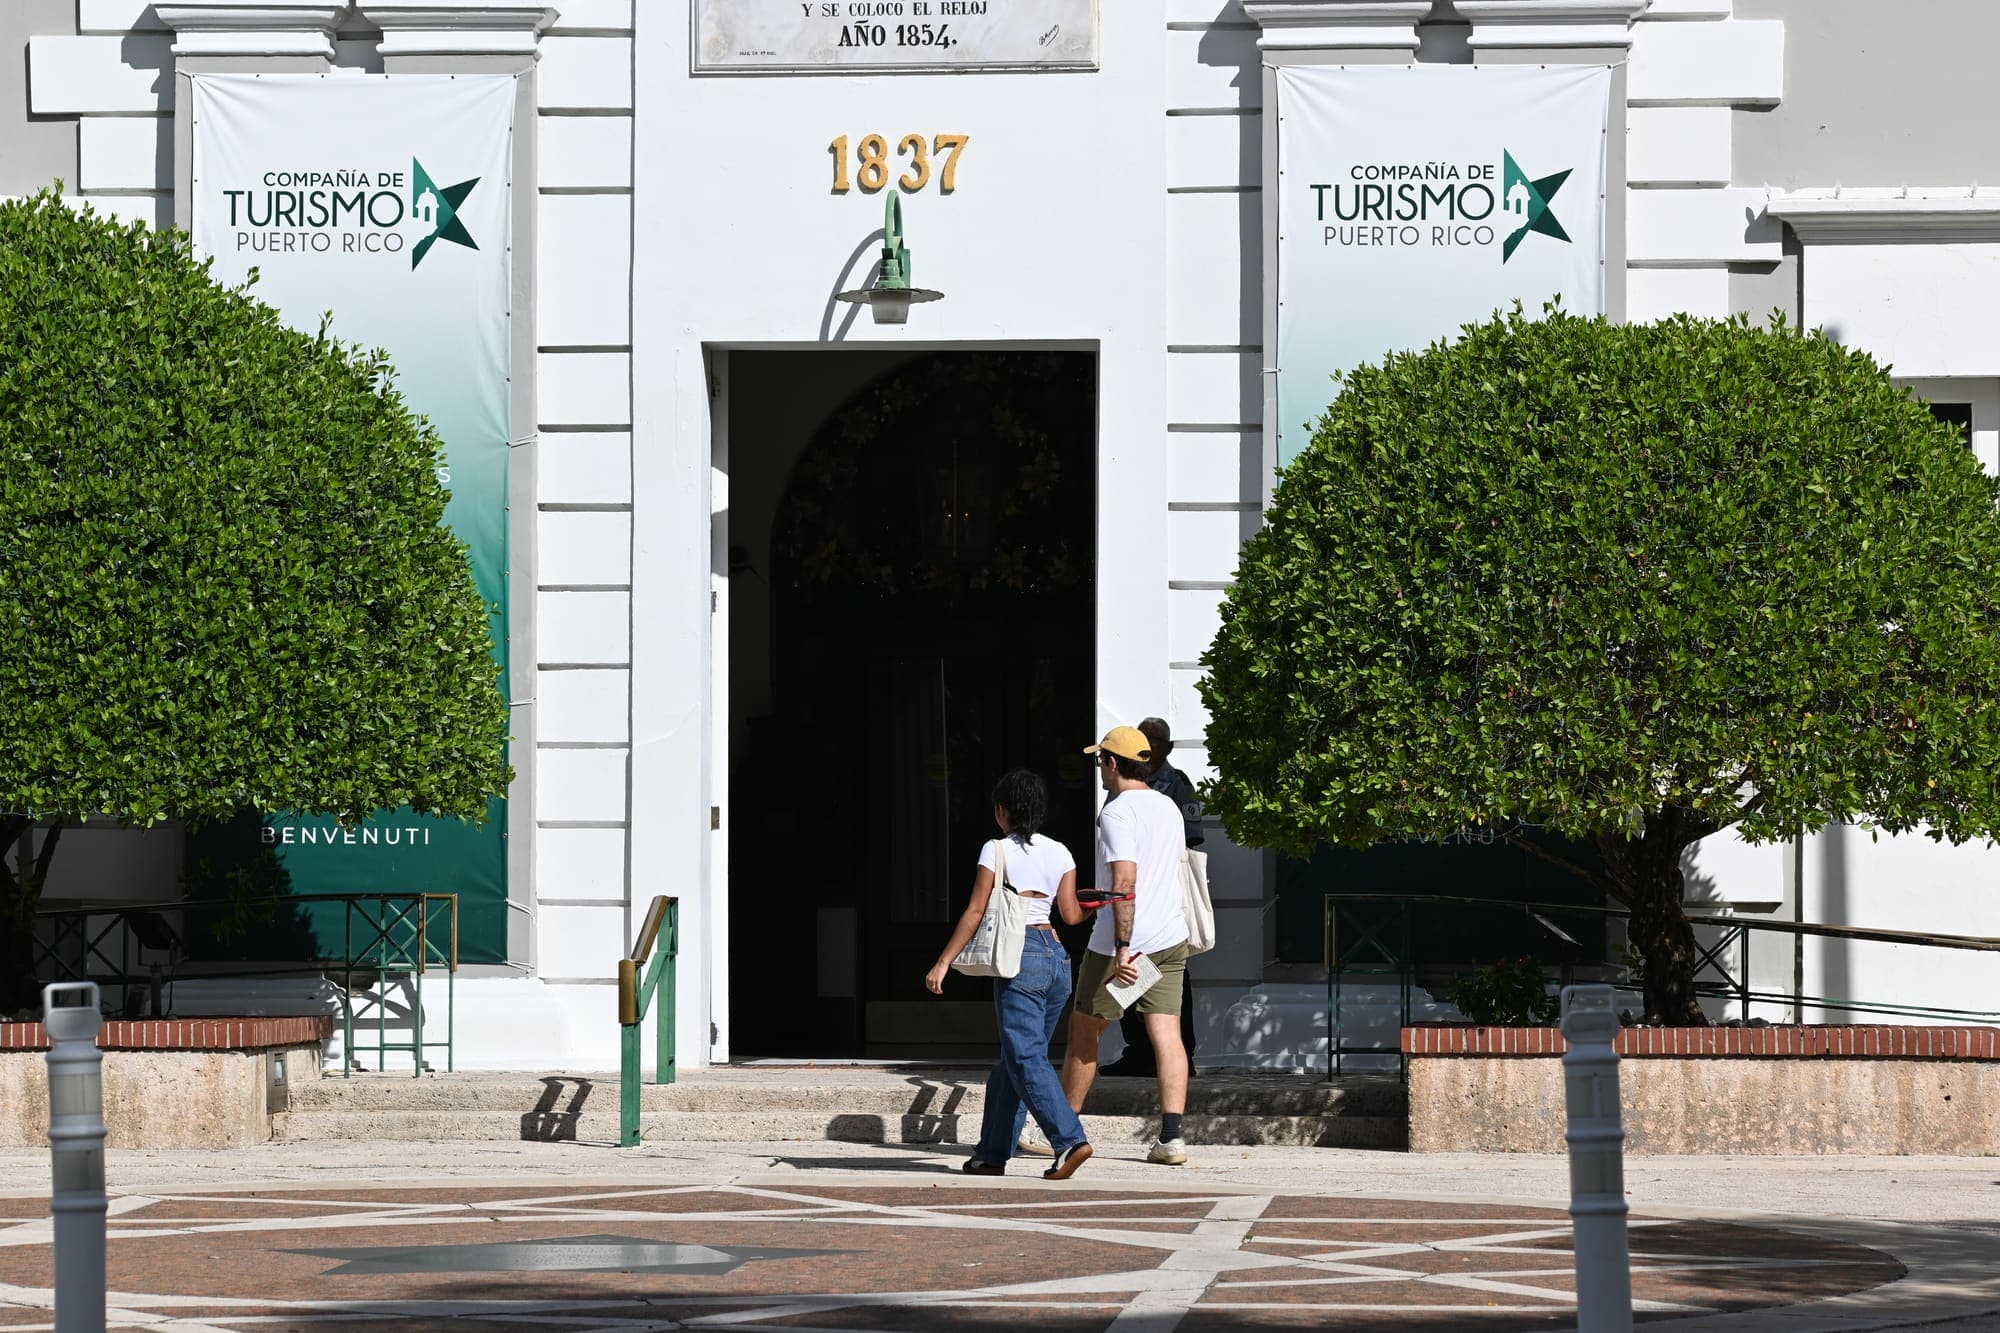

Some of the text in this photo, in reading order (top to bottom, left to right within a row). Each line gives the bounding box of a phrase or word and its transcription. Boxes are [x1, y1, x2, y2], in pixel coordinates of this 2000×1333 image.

[801, 1, 987, 17] Y SE COLOCO EL RELOJ
[838, 20, 958, 49] AÑO 1854.
[828, 134, 969, 195] 1837
[1351, 162, 1495, 180] COMPAÑÍA DE
[263, 169, 404, 187] COMPAÑÍA DE
[223, 190, 404, 227] TURISMO
[1310, 183, 1495, 221] TURISMO
[237, 232, 404, 252] PUERTO RICO
[1324, 226, 1494, 246] PUERTO RICO
[260, 826, 430, 845] BENVENUTI
